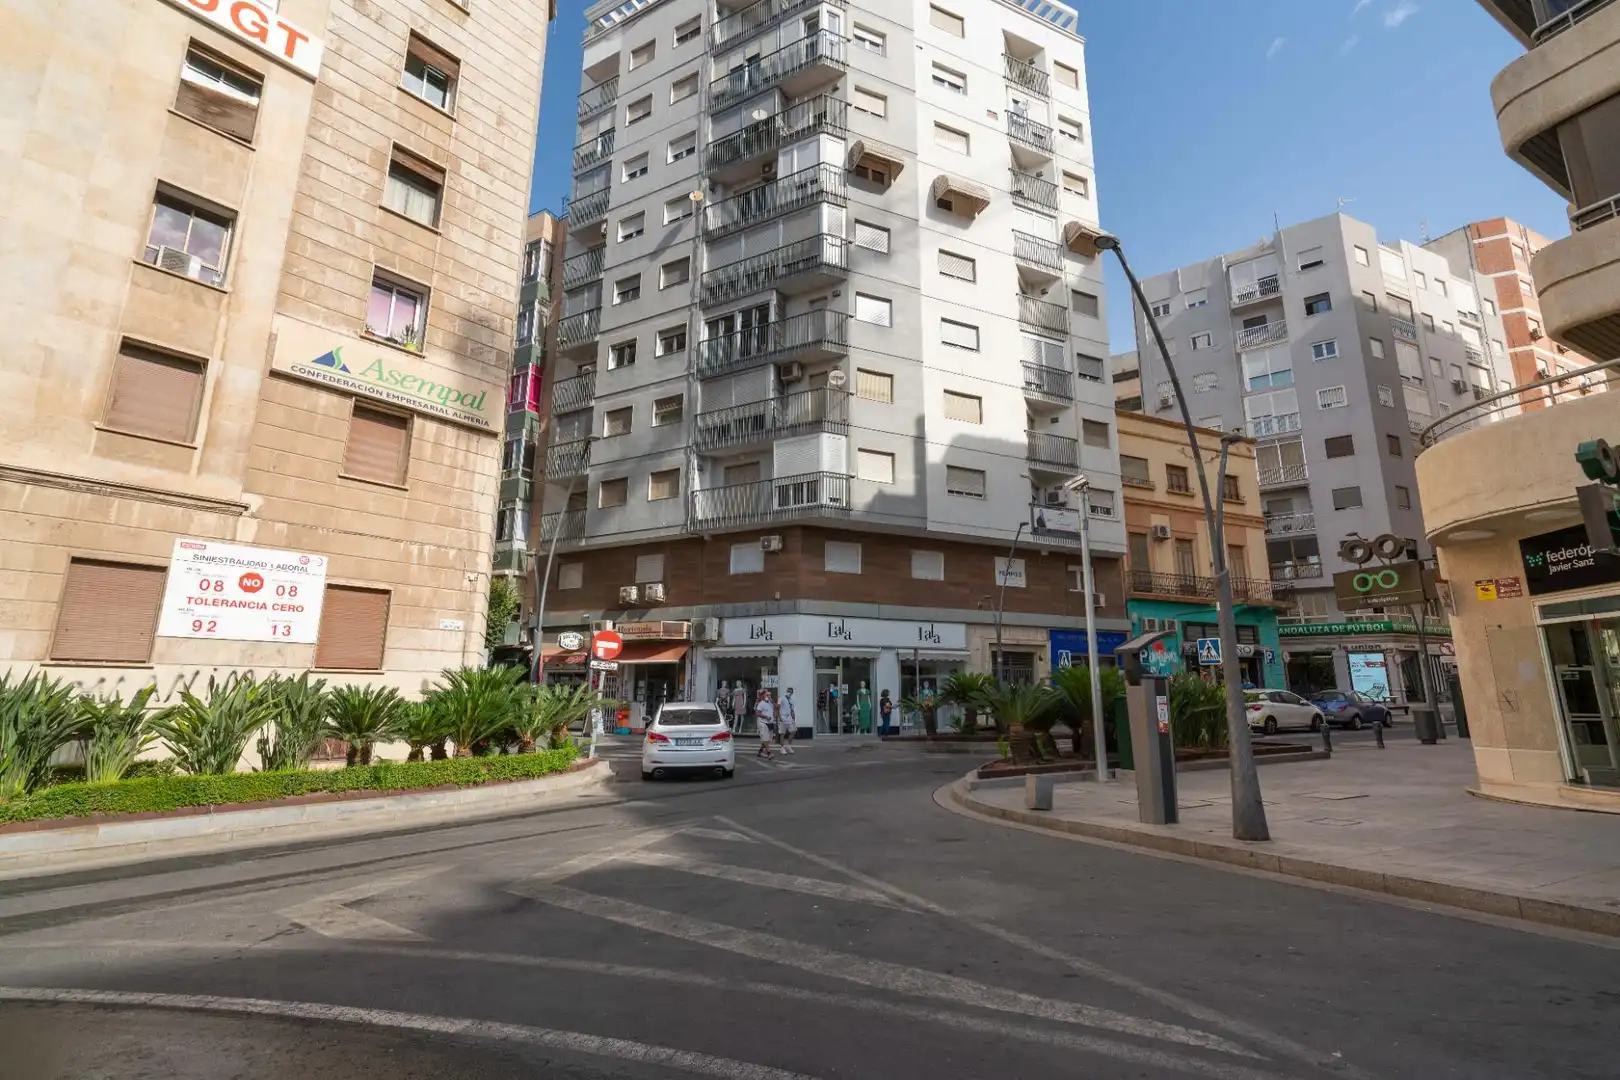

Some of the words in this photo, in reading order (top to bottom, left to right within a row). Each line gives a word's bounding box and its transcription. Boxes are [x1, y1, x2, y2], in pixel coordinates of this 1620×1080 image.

[358, 358, 487, 411] Asempal
[386, 391, 450, 416] EMPRESARIAL
[193, 553, 268, 569] SINIESTRALIDAD
[270, 563, 309, 573] LABORAL
[1549, 562, 1571, 575] Javier
[1573, 558, 1594, 568] Sanz
[243, 578, 261, 587] NO
[186, 596, 268, 610] TOLERANCIA
[271, 603, 305, 613] CERO
[192, 619, 217, 633] 92
[271, 624, 292, 637] 13
[749, 619, 773, 641] Lala
[827, 619, 852, 641] Lala
[918, 623, 941, 644] Lala
[1331, 625, 1346, 633] DE
